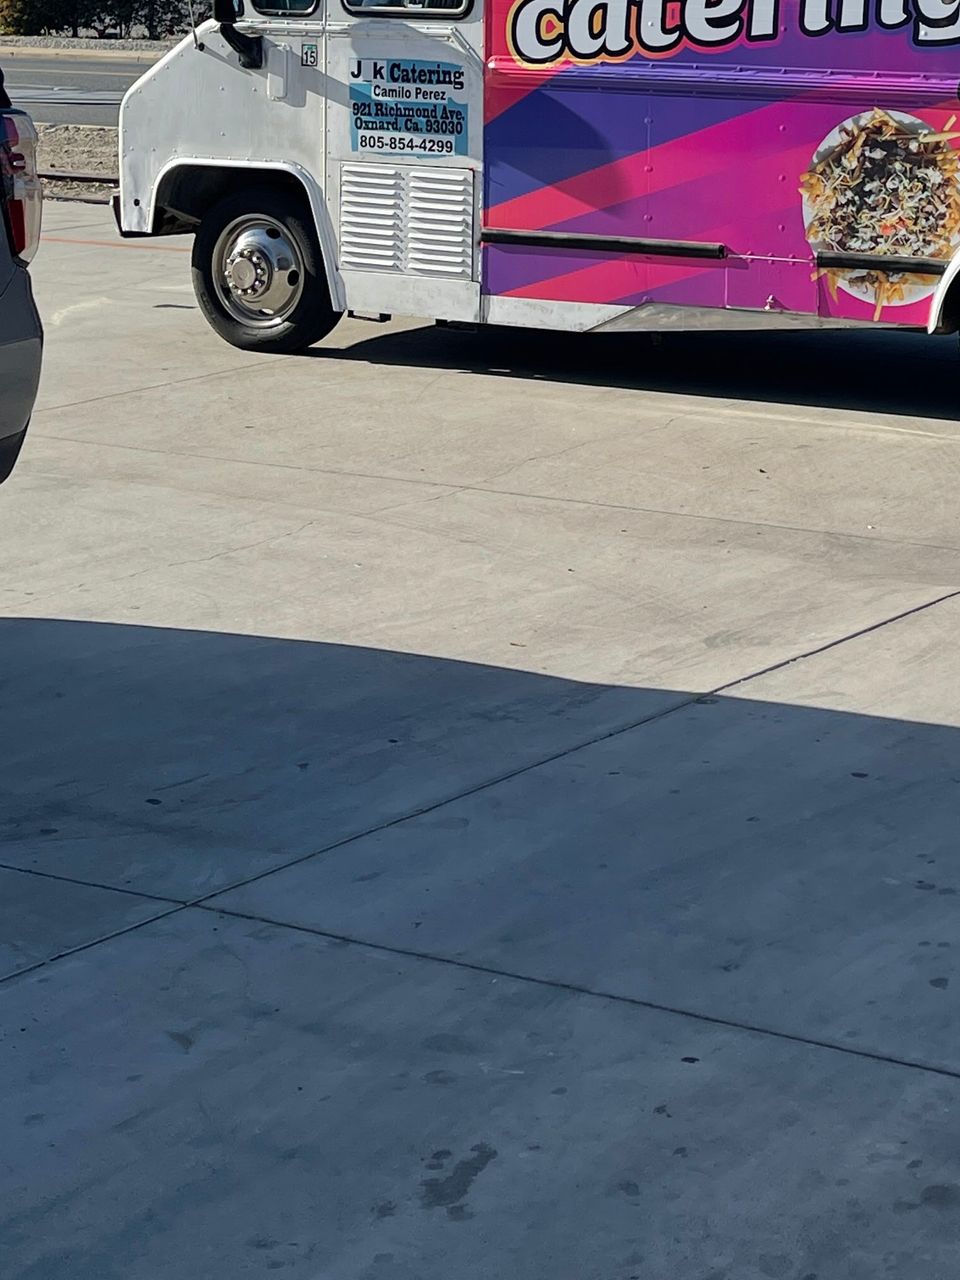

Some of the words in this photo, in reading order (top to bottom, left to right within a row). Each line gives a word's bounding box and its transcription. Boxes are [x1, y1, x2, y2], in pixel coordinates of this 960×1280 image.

[304, 50, 316, 65] 15
[389, 62, 464, 90] Catering
[373, 85, 412, 99] Camilo
[415, 87, 446, 101] Perez
[352, 102, 373, 117] 921
[374, 103, 437, 119] Richmond
[425, 120, 463, 135] 93030
[359, 135, 454, 153] 805-854-4299
